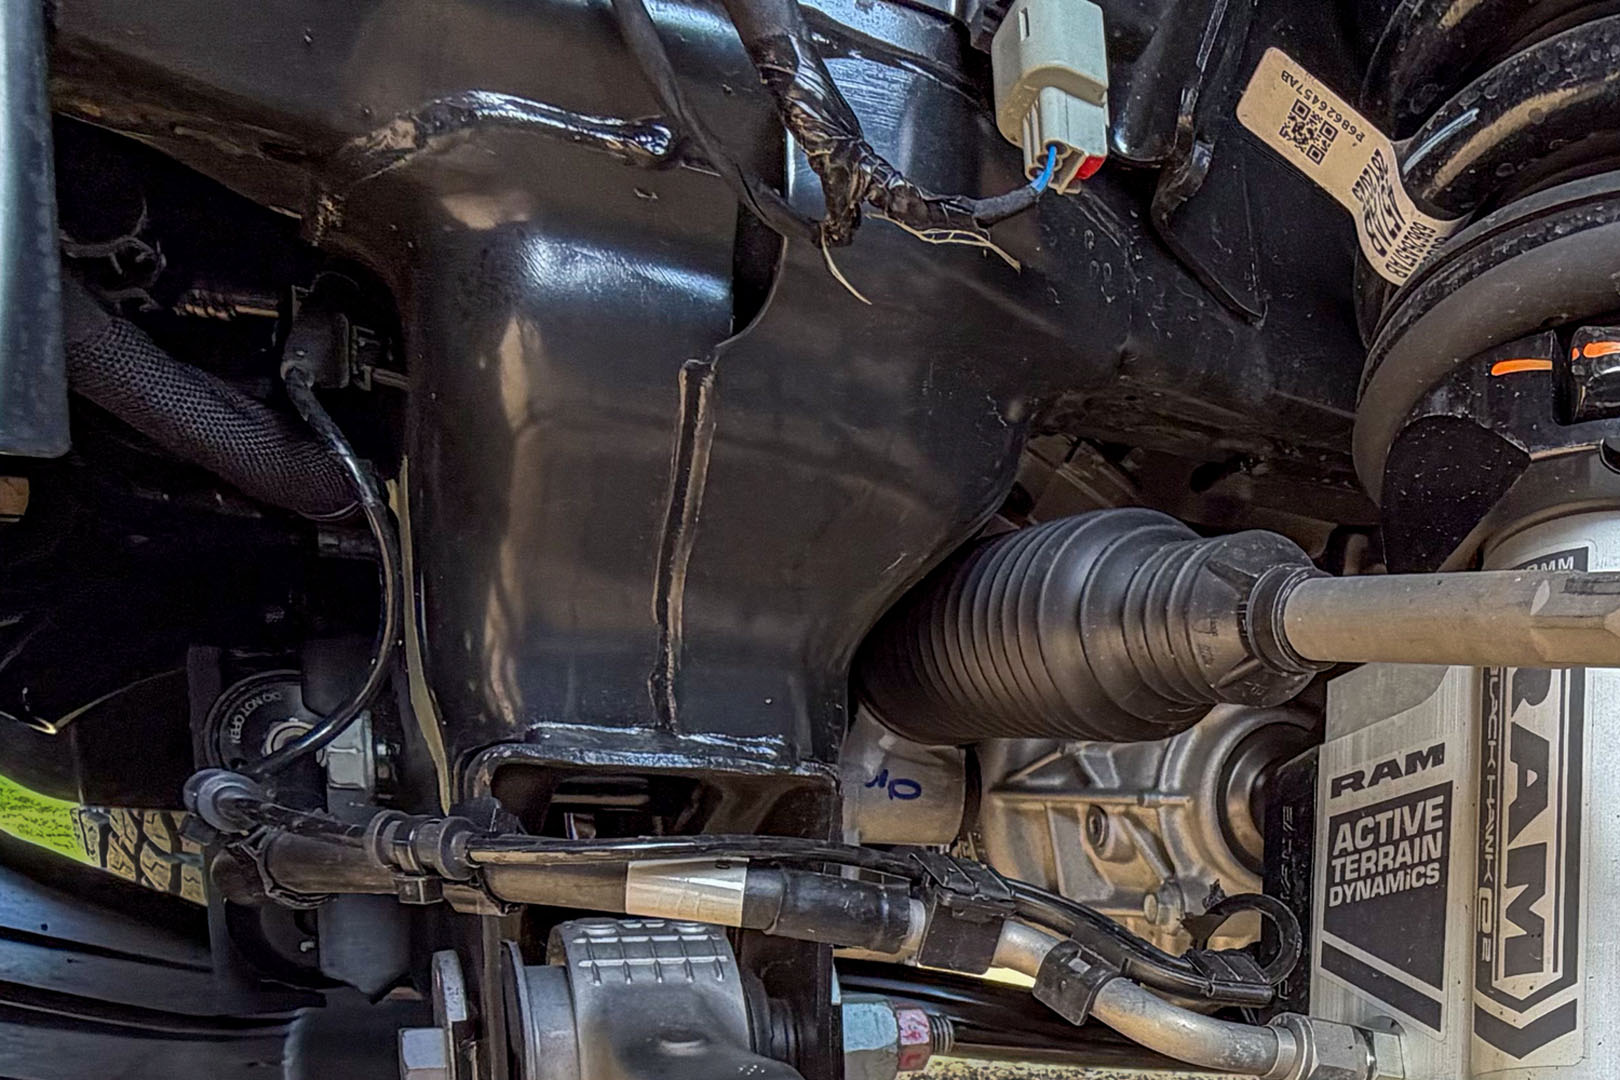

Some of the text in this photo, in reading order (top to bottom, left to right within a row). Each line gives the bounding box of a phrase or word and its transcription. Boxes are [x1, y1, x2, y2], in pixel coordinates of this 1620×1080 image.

[1281, 70, 1366, 143] P68626457AB
[1330, 742, 1445, 799] RAM
[1332, 795, 1444, 856] ACTIVE
[1331, 831, 1443, 883] TERRAIN
